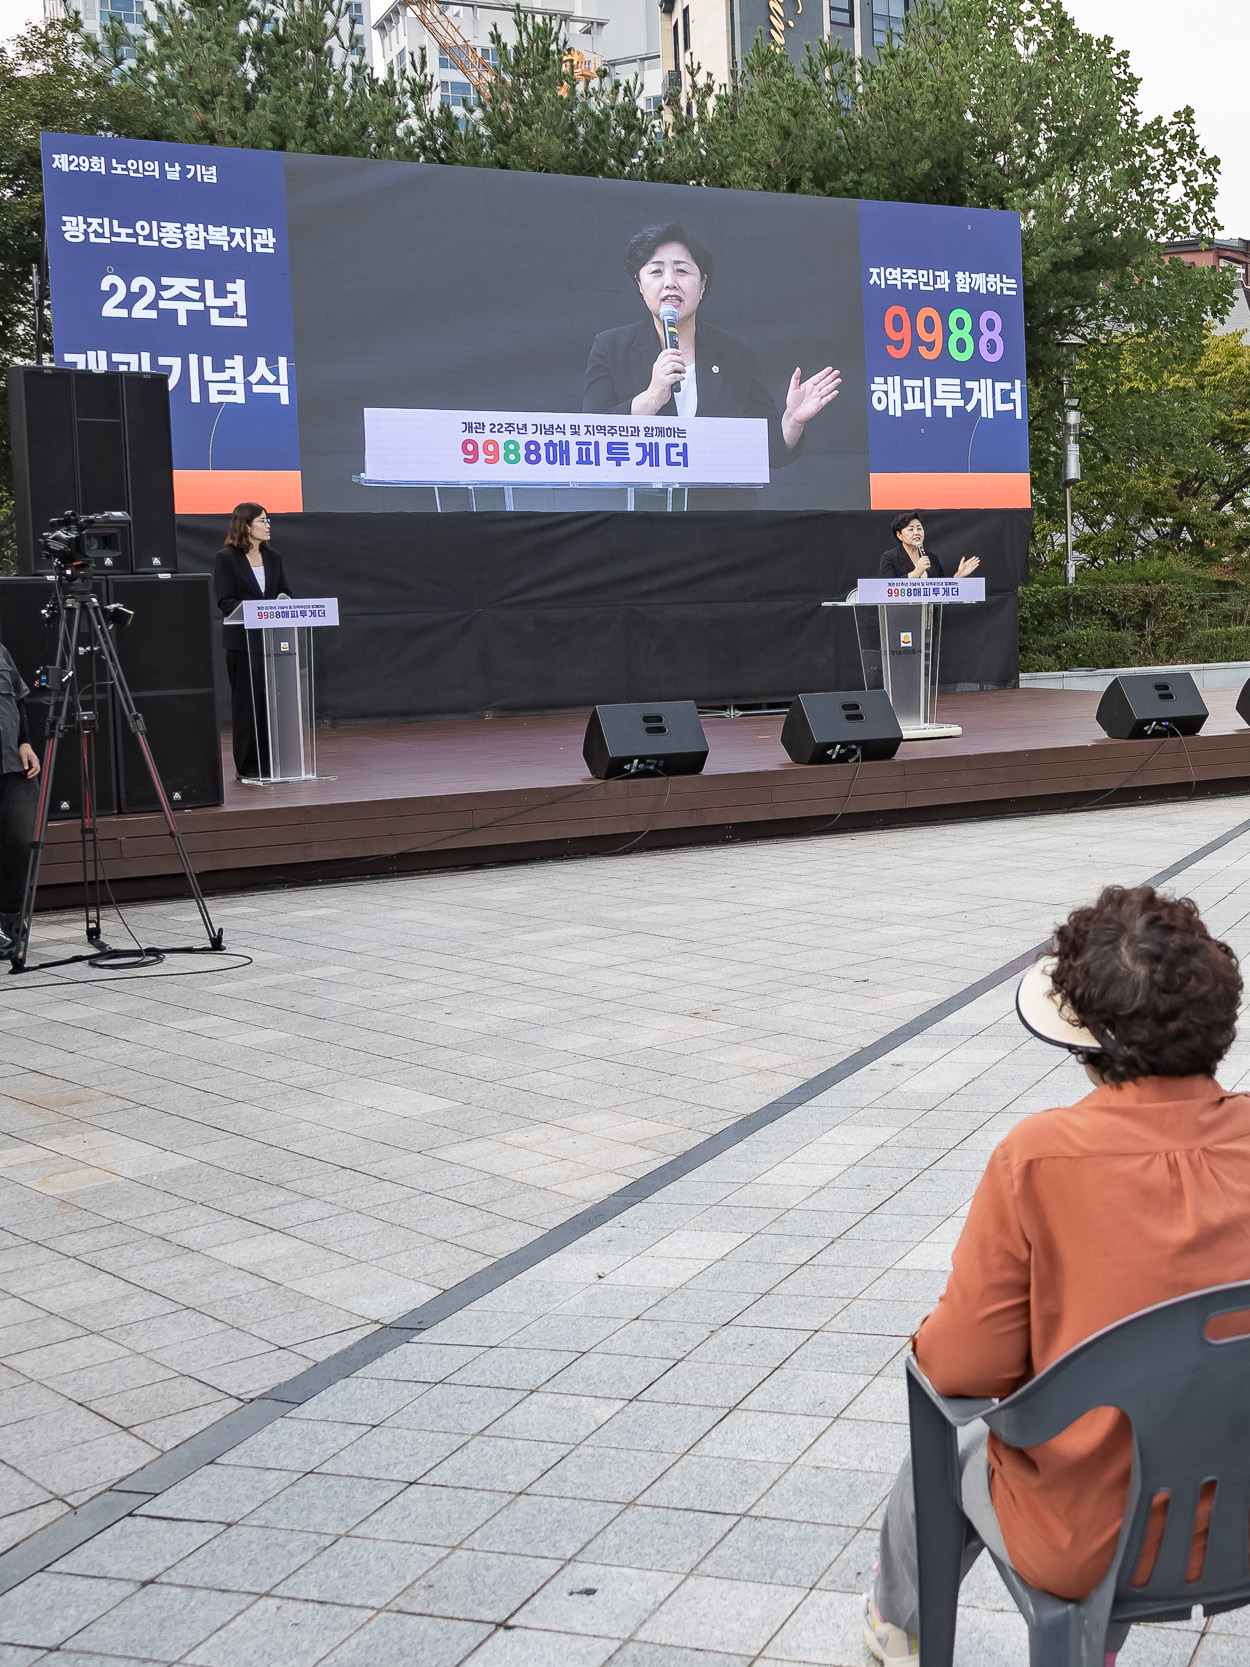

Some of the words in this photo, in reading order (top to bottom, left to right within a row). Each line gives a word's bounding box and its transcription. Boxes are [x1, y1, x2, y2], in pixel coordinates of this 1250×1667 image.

[51, 153, 106, 175] 제29회
[110, 158, 160, 179] 노인의
[164, 162, 182, 181] 날
[185, 164, 218, 183] 기념
[61, 215, 277, 254] 광진노인종합복지관
[868, 266, 951, 292] 지역주민과
[954, 271, 1018, 296] 함께하는
[100, 274, 248, 327] 22주년
[884, 305, 1005, 363] 9988
[870, 375, 1023, 420] 해피투게더
[461, 421, 486, 435] 개관
[489, 422, 528, 436] 22주년
[531, 423, 566, 437] 기념식
[569, 424, 581, 437] 및
[584, 424, 641, 438] 지역주민과
[643, 425, 687, 439] 함께하는
[461, 438, 689, 468] 9988해피투게더
